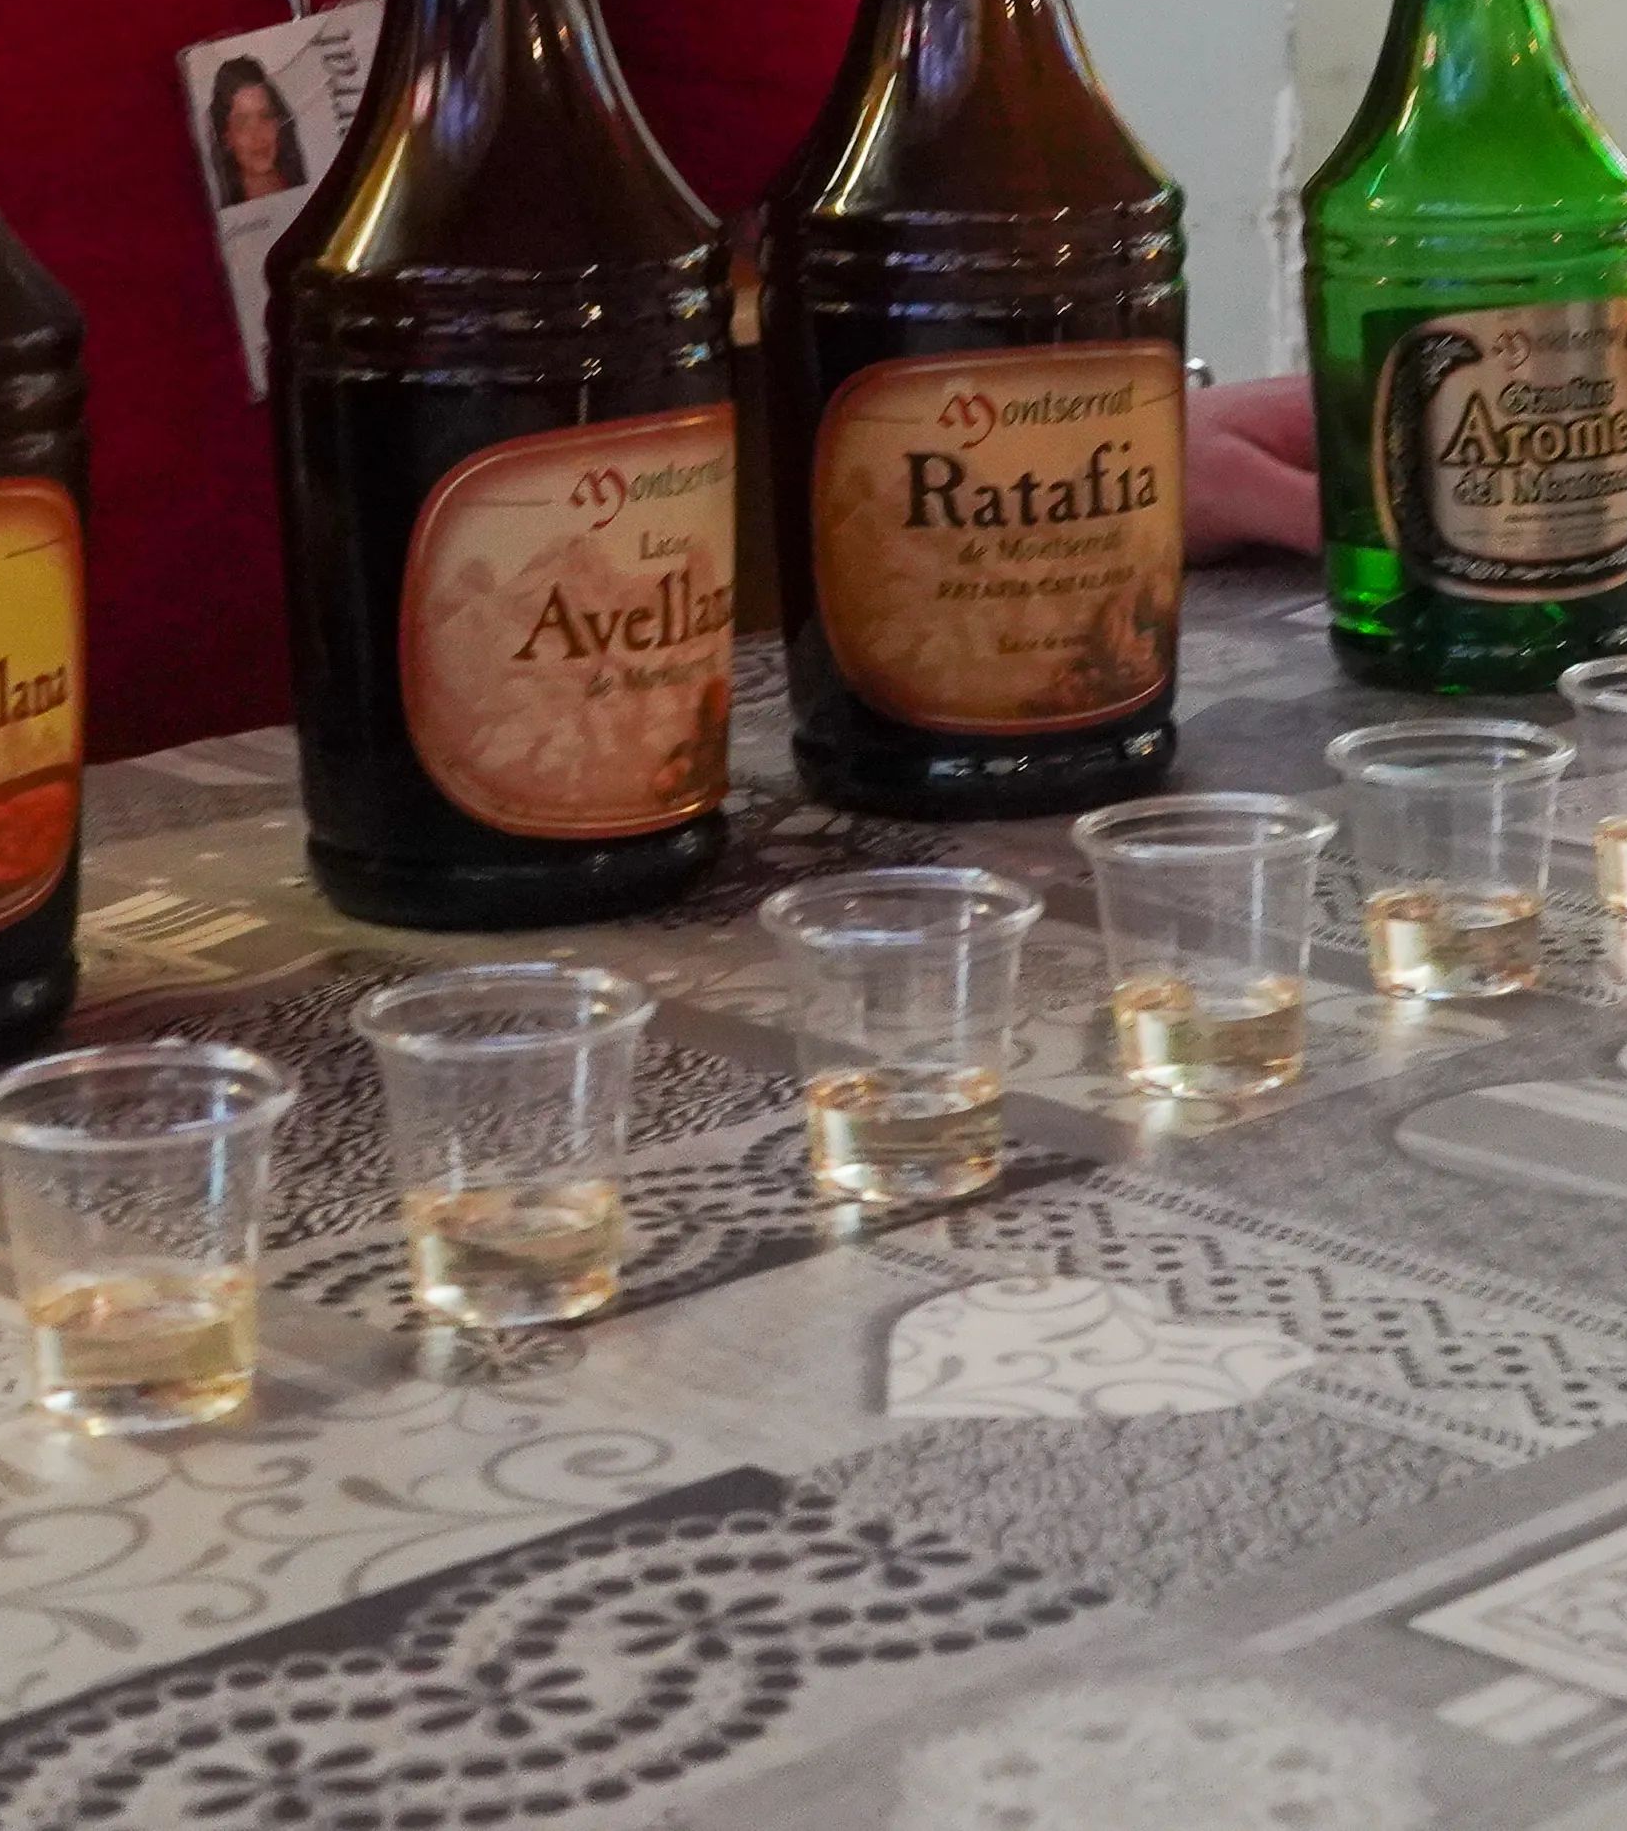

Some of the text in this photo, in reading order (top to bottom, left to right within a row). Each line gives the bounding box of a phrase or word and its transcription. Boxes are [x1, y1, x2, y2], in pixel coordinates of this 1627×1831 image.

[937, 379, 1136, 449] Montserrat
[903, 440, 1160, 530] Ratafia
[512, 569, 734, 662] Avellan
